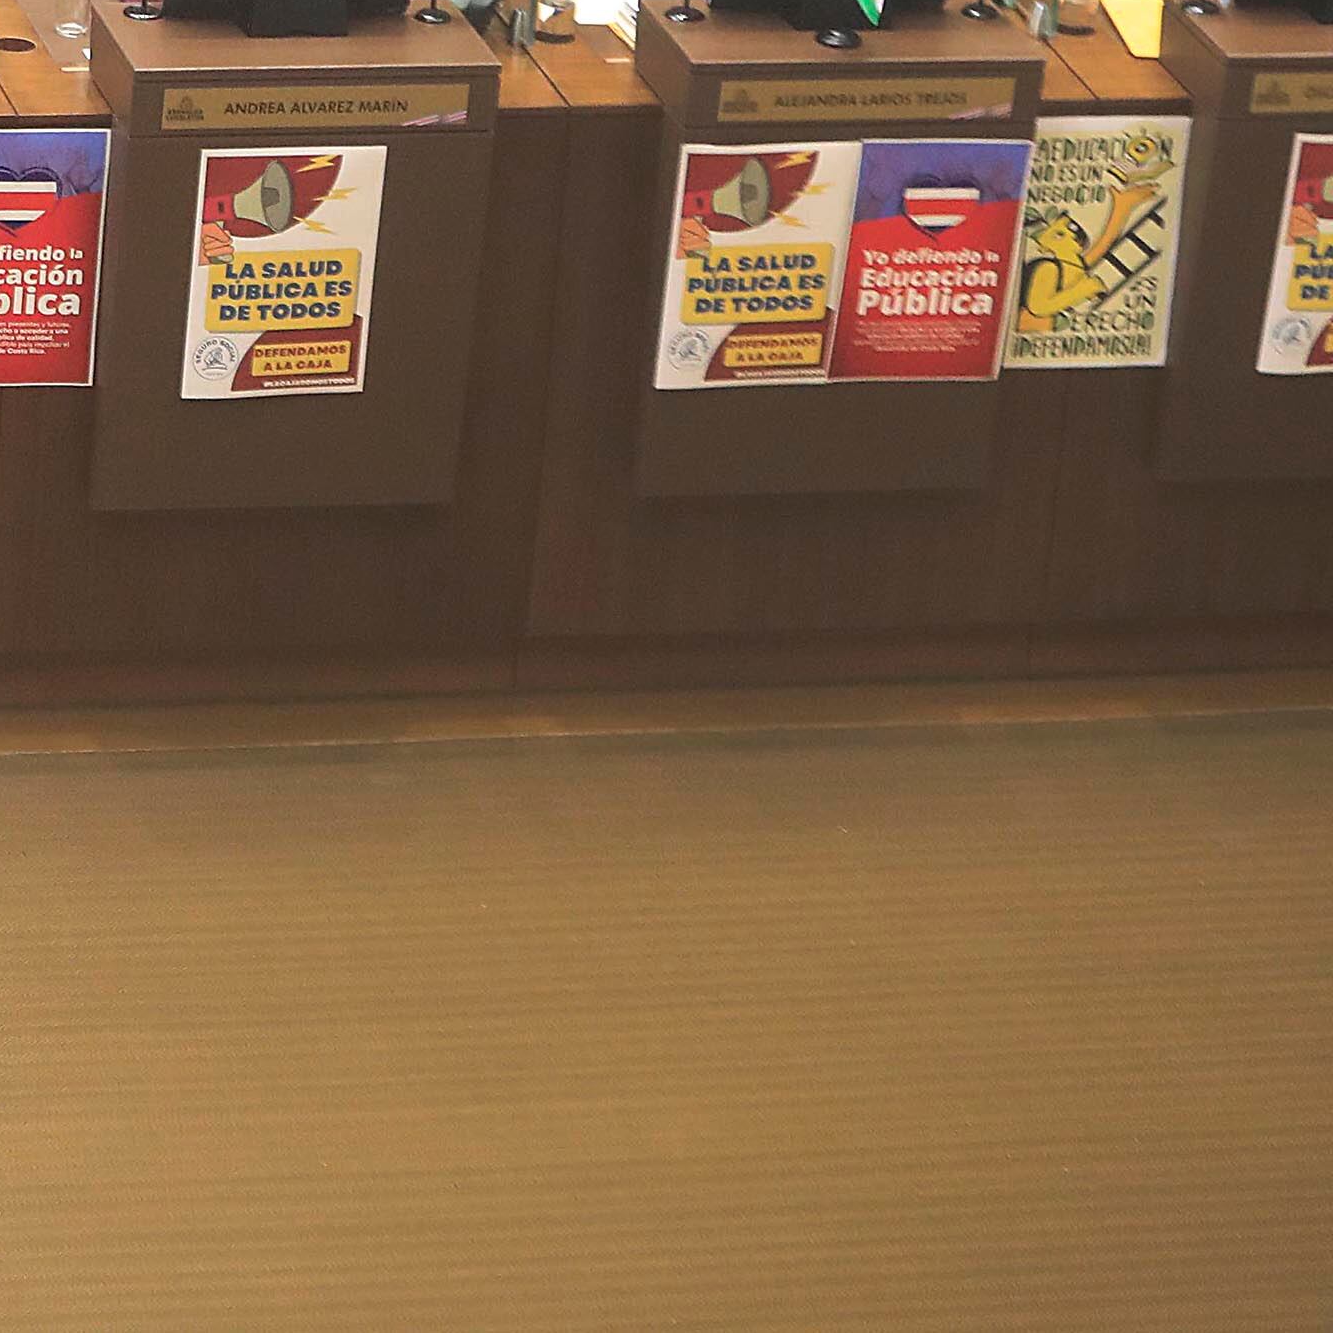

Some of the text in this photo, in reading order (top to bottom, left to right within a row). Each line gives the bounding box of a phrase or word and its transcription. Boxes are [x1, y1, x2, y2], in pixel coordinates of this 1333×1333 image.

[224, 101, 285, 115] ANDREA
[70, 248, 82, 259] la
[703, 254, 815, 271] LA SALUD
[863, 248, 999, 265] Yo defiendo la
[226, 261, 342, 279] LA SALUD
[861, 267, 998, 288] Educación
[212, 279, 351, 300] PÚBLICA ES
[689, 272, 824, 292] PÚBLICA ES
[696, 295, 813, 312] DE TODOS
[857, 287, 993, 316] Pública
[220, 302, 340, 321] DE TODOS
